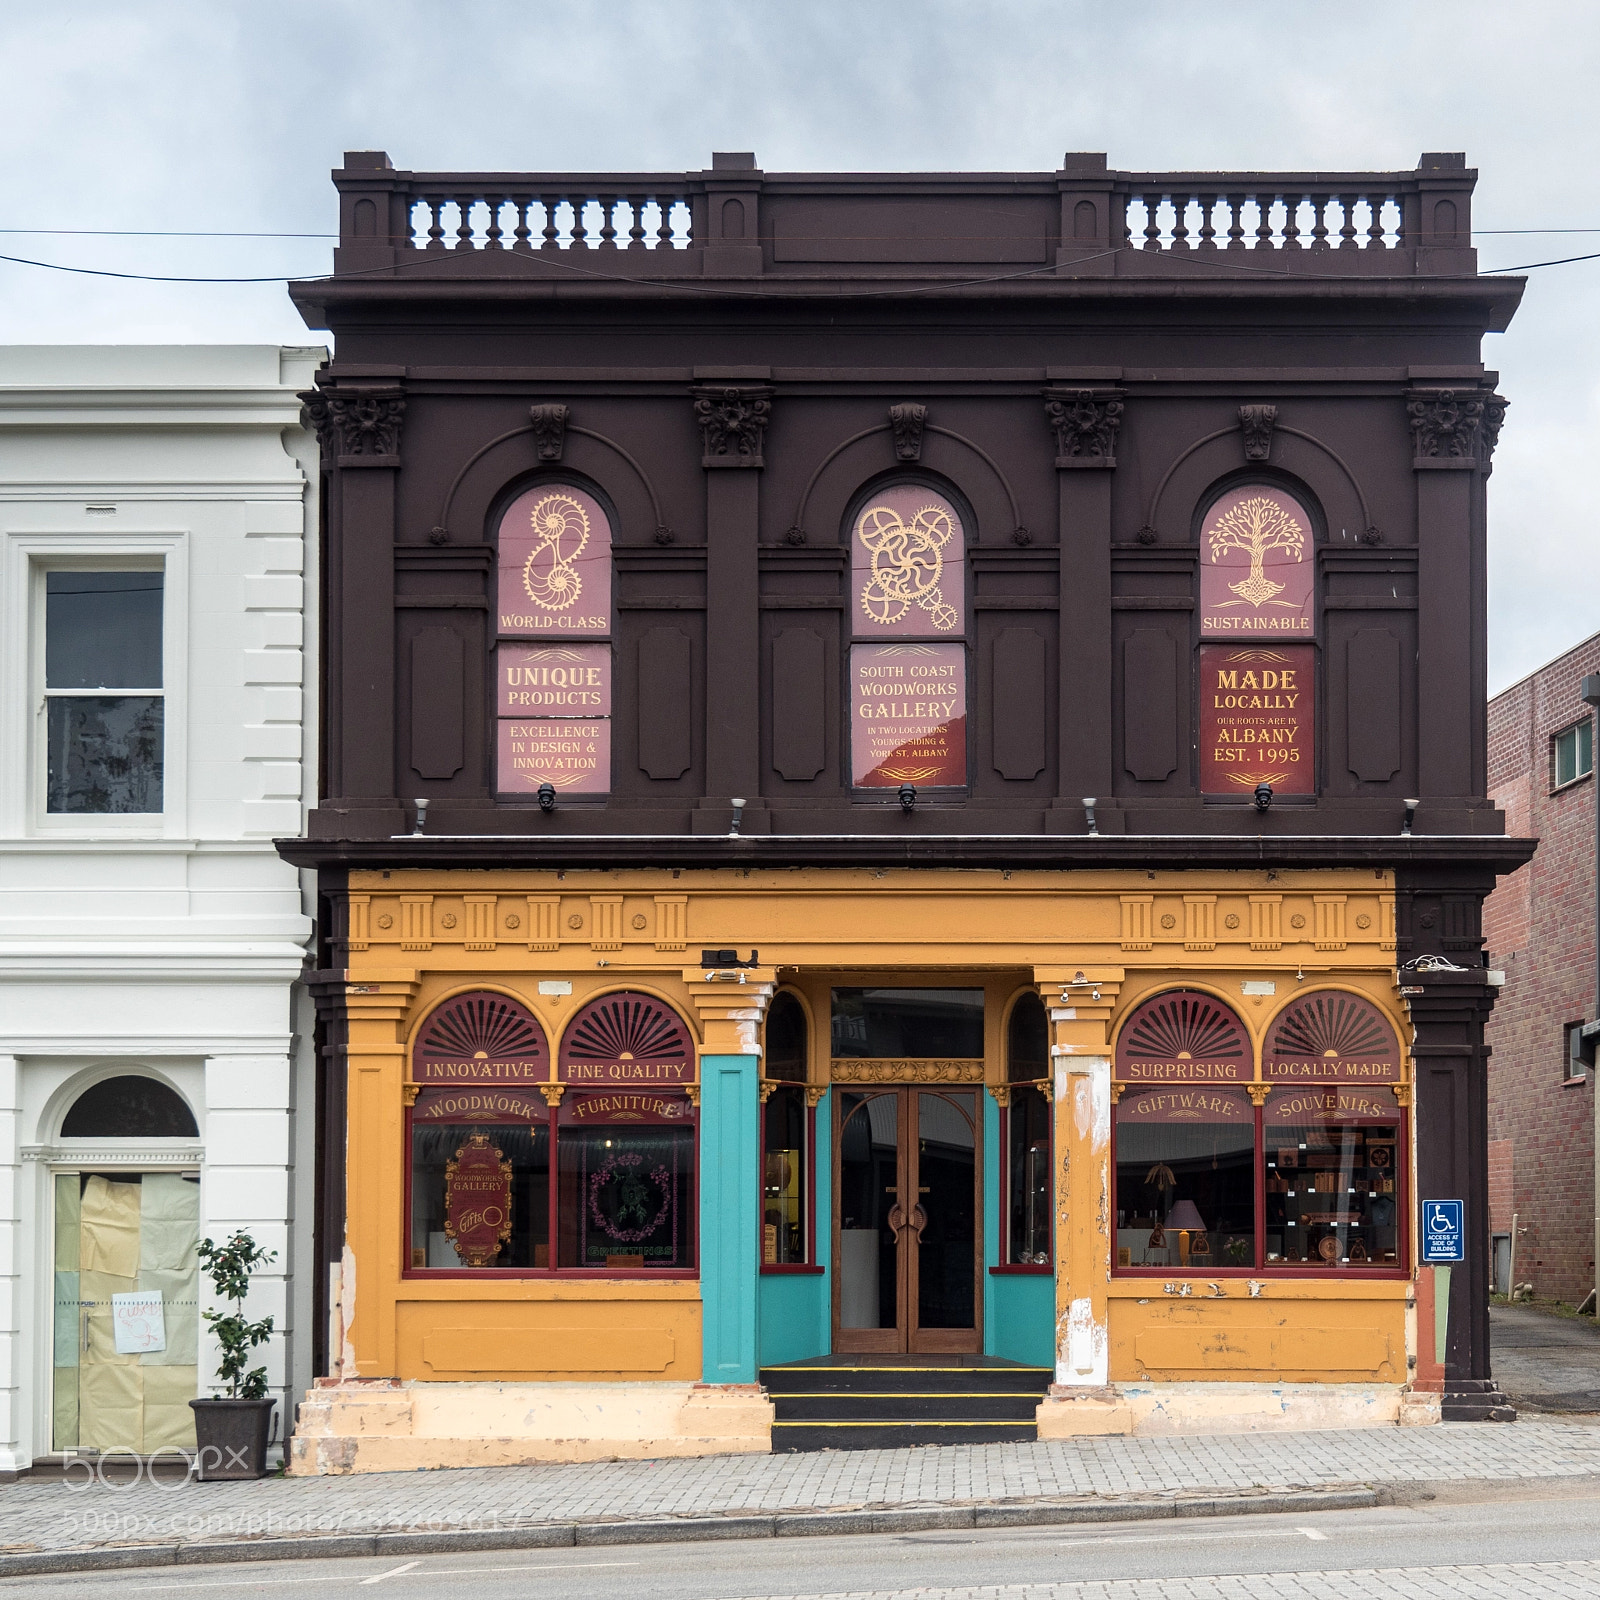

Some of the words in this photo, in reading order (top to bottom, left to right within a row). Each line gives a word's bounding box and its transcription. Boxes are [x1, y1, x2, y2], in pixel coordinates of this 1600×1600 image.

[501, 614, 606, 629] WORLD-CLASS
[1203, 617, 1309, 629] SUSTAINABLE
[507, 667, 602, 688] UNIQUE
[859, 666, 904, 678] SOUTH
[910, 665, 956, 677] COAST
[1217, 670, 1298, 690] MADE
[859, 682, 957, 696] WOODWORKS
[508, 691, 601, 706] PRODUCTS
[1214, 693, 1300, 709] LOCALLY
[859, 699, 956, 718] GALLERY
[1217, 717, 1235, 725] OUR
[1237, 717, 1265, 725] ROOTS
[1267, 717, 1286, 725] ARE
[1288, 717, 1297, 725] IN
[510, 726, 600, 738] EXCELLENCE
[867, 727, 876, 735] IN
[878, 726, 897, 735] TWO
[899, 726, 948, 734] LOCATIONS
[1217, 726, 1299, 743] ALBANY
[512, 742, 525, 753] IN
[531, 742, 581, 753] DESIGN
[586, 742, 597, 753] &
[908, 737, 937, 745] SIDING
[870, 750, 894, 758] YORK
[911, 748, 949, 757] ALBANY
[1214, 748, 1251, 762] EST.
[1258, 748, 1300, 763] 1995
[513, 757, 596, 769] INNOVATION
[426, 1061, 535, 1077] INNOVATIVE
[567, 1065, 604, 1078] FINE
[609, 1063, 687, 1079] QUALITY
[1130, 1063, 1237, 1078] SURPRISING
[1269, 1061, 1343, 1076] LOCALLY
[1346, 1063, 1392, 1076] MADE
[428, 1094, 535, 1119] WOODWORK
[576, 1095, 678, 1118] FURNITURE
[1137, 1092, 1235, 1116] GIFTWARE
[1279, 1094, 1382, 1118] SOUVENIRS
[455, 1174, 503, 1182] WOODWORKS
[453, 1181, 504, 1191] GALLERY
[460, 1212, 482, 1233] Gifts
